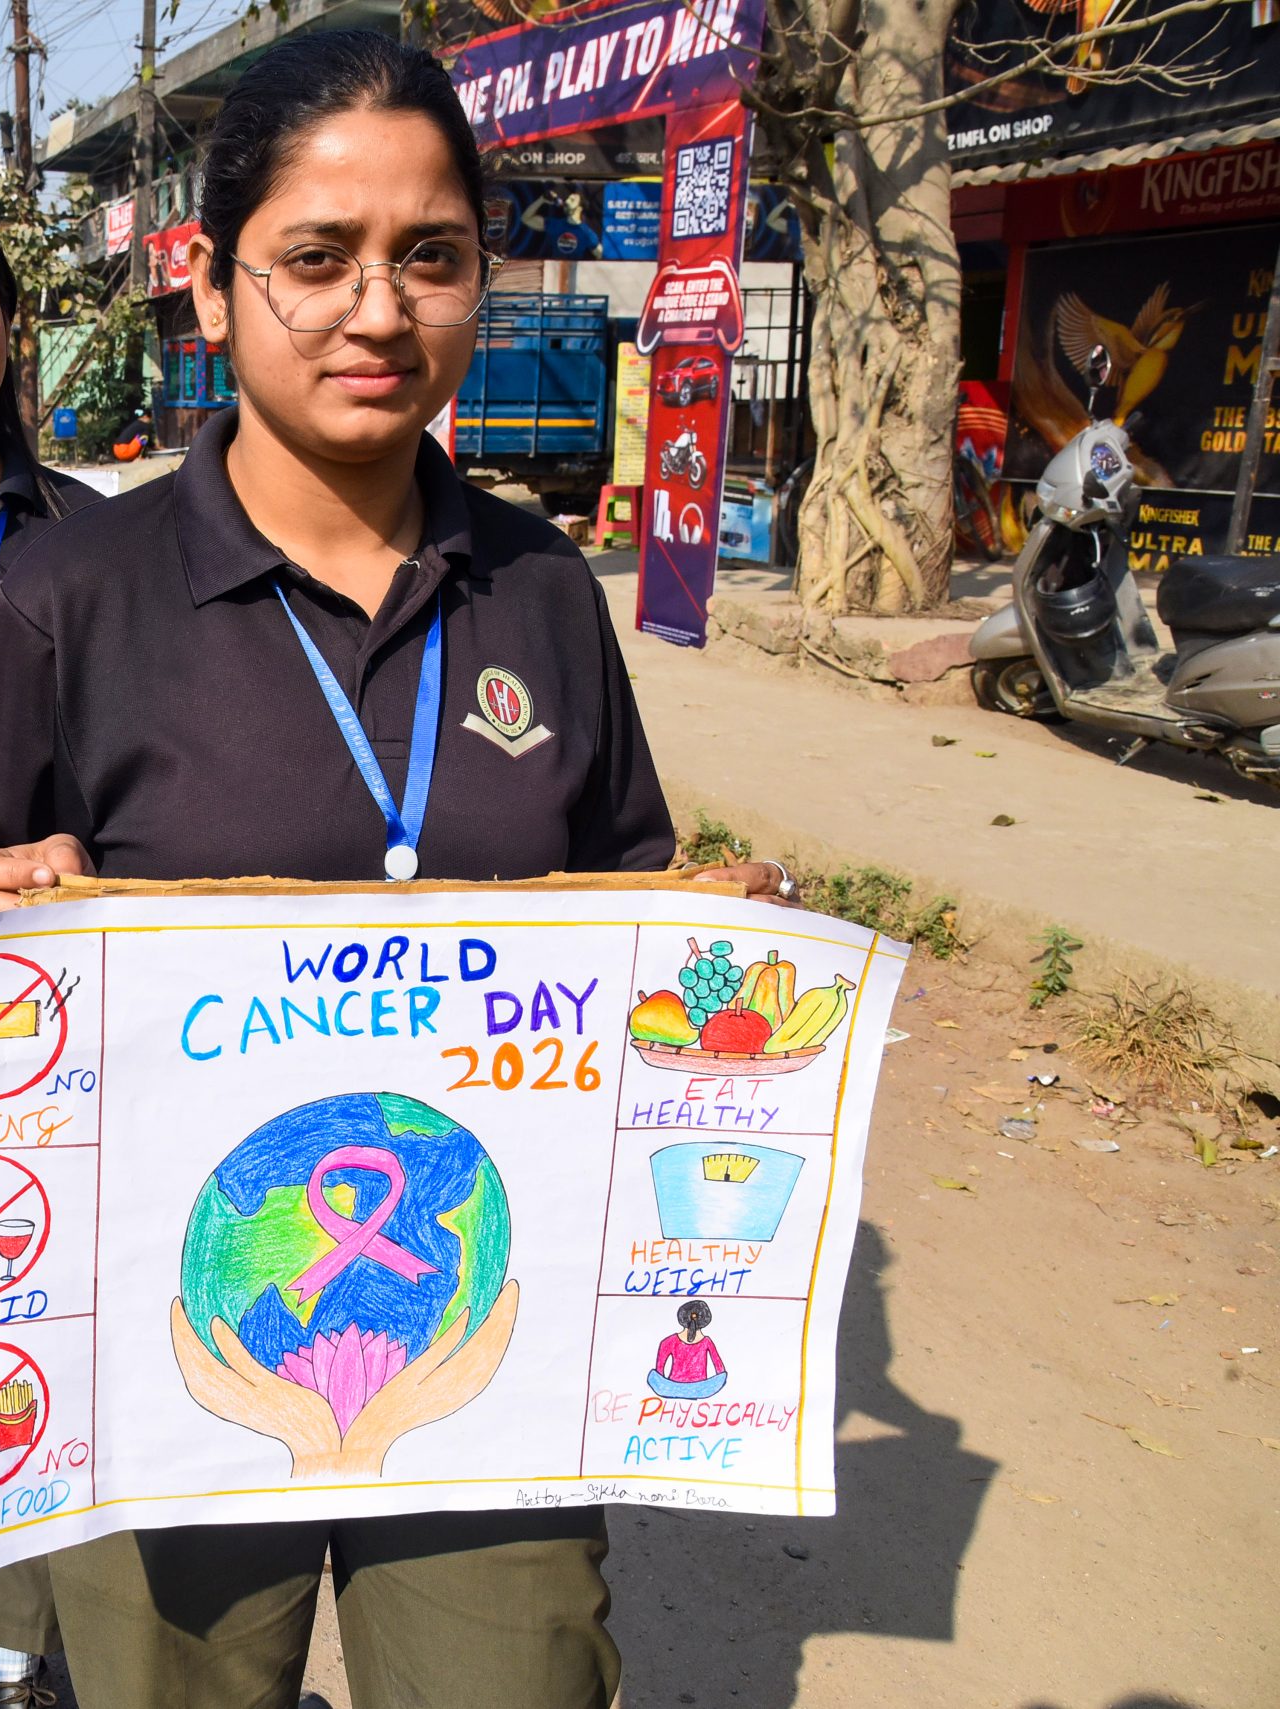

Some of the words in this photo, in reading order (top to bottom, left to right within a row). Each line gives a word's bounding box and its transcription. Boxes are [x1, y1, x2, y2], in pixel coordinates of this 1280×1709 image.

[453, 74, 492, 125] ME
[493, 60, 534, 125] ON.
[543, 32, 620, 104] PLAY
[620, 15, 664, 81] TO
[668, 0, 742, 67] WIN.
[957, 129, 988, 149] IMFL
[988, 123, 1011, 142] ON
[1013, 114, 1053, 138] SHOP
[520, 152, 543, 164] ON
[546, 152, 586, 165] SHOP
[1214, 407, 1246, 427] THE
[1201, 431, 1247, 453] GOLD
[1140, 504, 1200, 526] KINGFISHER
[1131, 531, 1203, 556] ULTRA
[1249, 534, 1272, 551] THE
[1128, 551, 1171, 571] MA
[283, 935, 497, 983] WORLD
[180, 986, 441, 1061] CANCER
[484, 978, 598, 1036] DAY
[441, 1038, 600, 1091] 2026
[46, 1068, 96, 1096] NO
[685, 1078, 773, 1101] EAT
[632, 1100, 779, 1130] HEALTHY
[631, 1240, 763, 1265] HEALTHY
[625, 1267, 752, 1296] WEIGHT
[592, 1389, 632, 1423] BE
[638, 1397, 796, 1432] PHYSICALLY
[38, 1438, 89, 1475] NO
[624, 1436, 742, 1469] ACTIVE
[1, 1480, 70, 1524] FOOD
